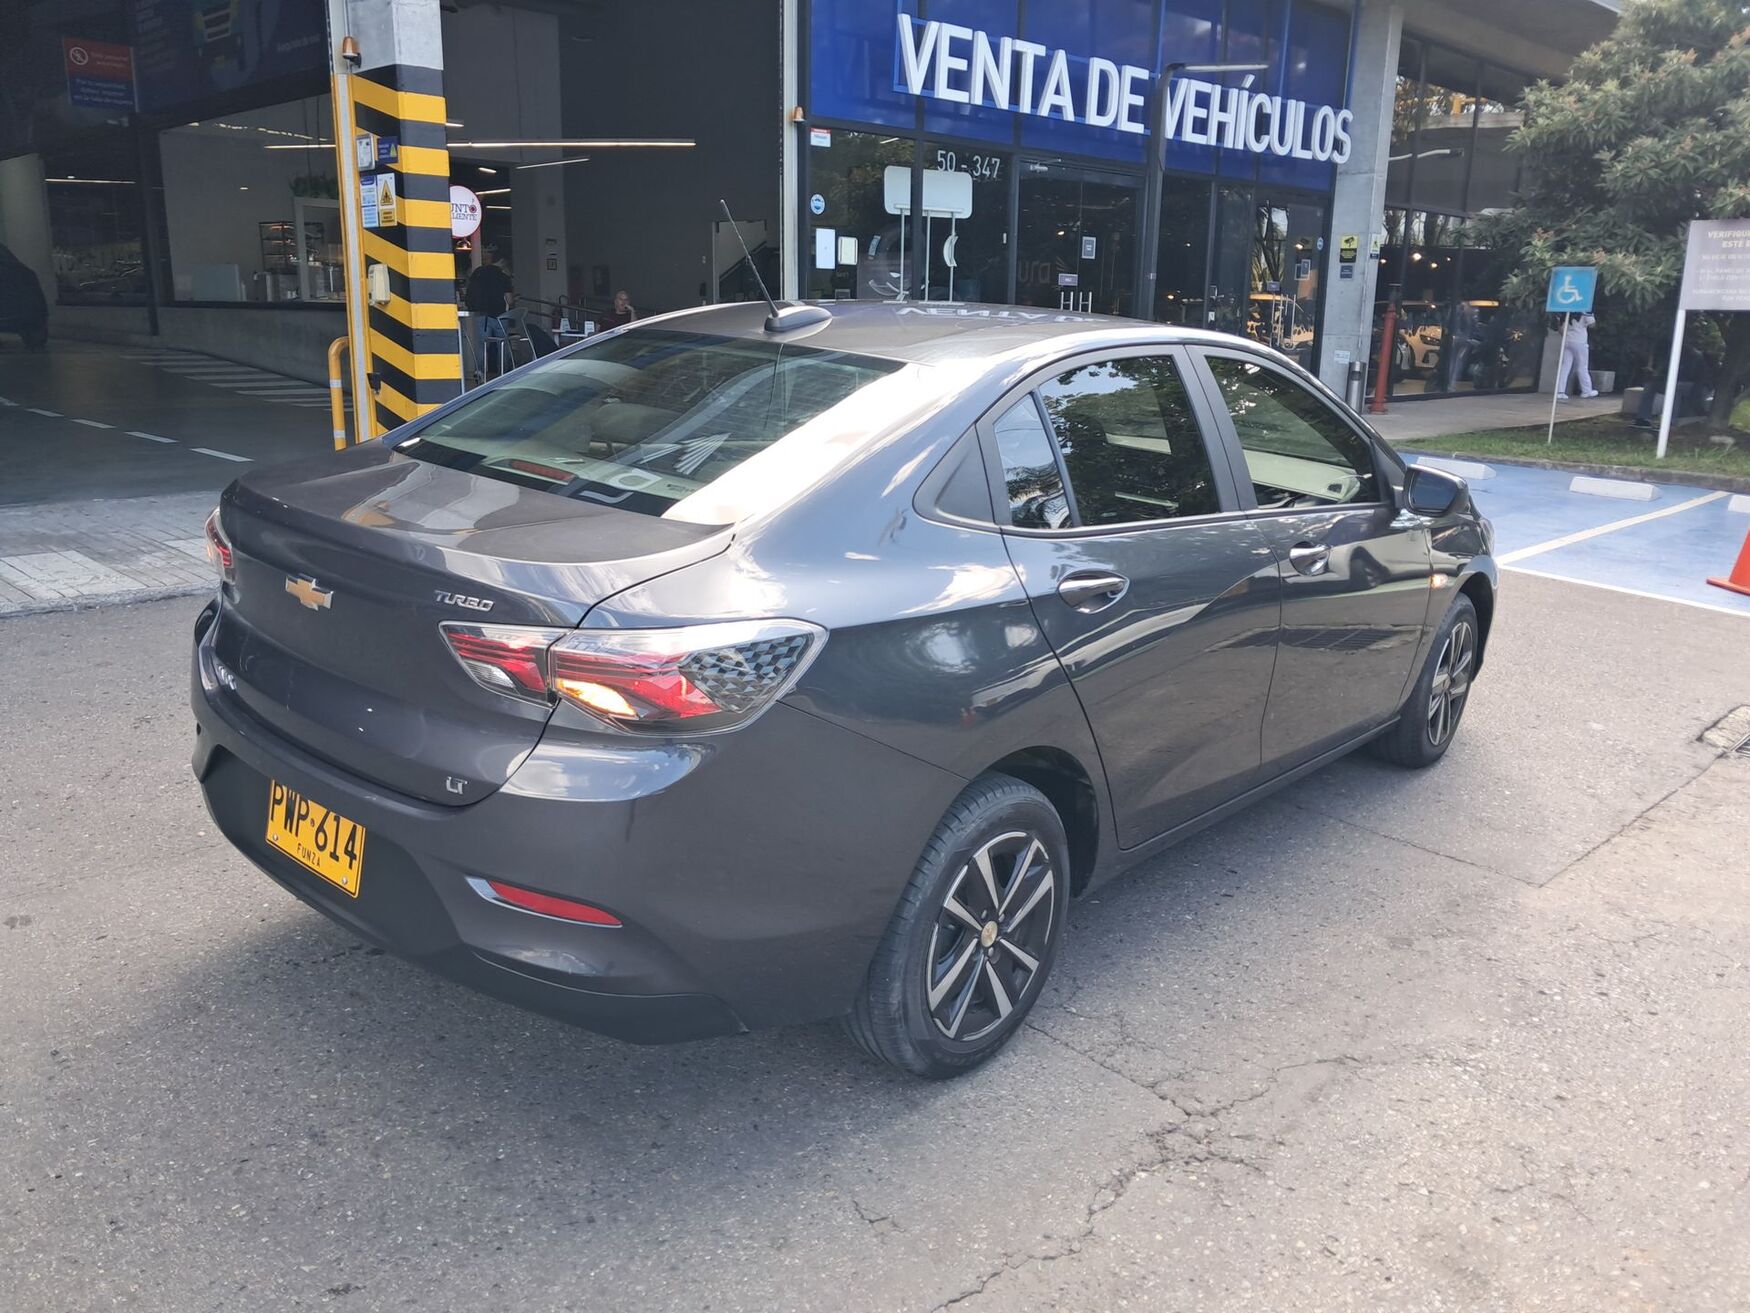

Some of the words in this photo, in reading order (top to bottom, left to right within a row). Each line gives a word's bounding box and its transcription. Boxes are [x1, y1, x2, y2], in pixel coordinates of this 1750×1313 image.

[898, 13, 1075, 121] VENTA
[1086, 57, 1150, 134] DE
[1166, 74, 1354, 164] VEHÍCULOS
[937, 149, 956, 172] 50
[972, 155, 1001, 178] 347
[451, 203, 478, 214] NTO
[451, 213, 478, 222] LIENTE
[434, 589, 494, 612] TURBO
[446, 776, 468, 795] LT
[296, 842, 321, 868] FUNZA
